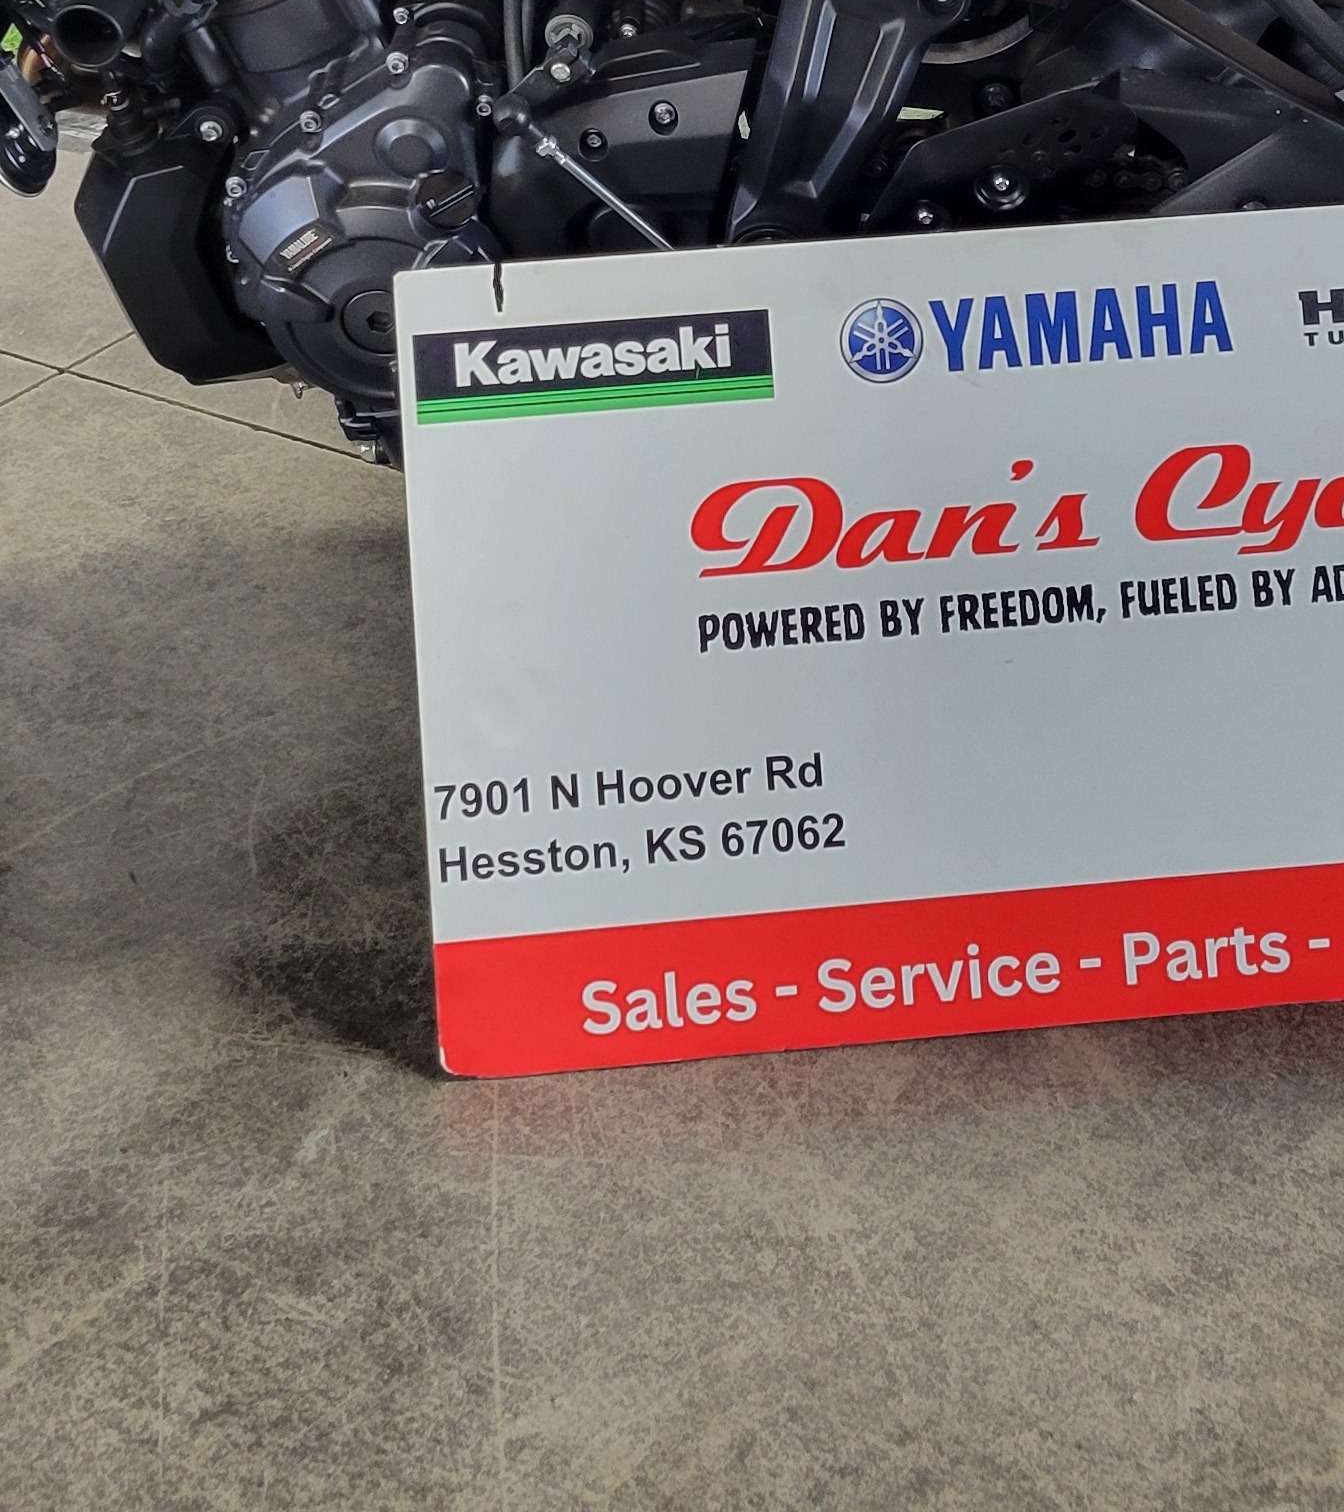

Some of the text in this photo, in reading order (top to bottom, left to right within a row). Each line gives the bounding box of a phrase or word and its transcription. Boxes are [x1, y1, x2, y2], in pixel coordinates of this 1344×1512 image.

[454, 324, 733, 390] Kawasaki
[928, 279, 1234, 373] YAMAHA
[689, 458, 1101, 580] Dan's
[697, 602, 866, 654] POWERED
[879, 597, 926, 638] BY
[939, 584, 1108, 634] FREEDOM,
[1119, 572, 1238, 620] FUELED
[1251, 568, 1296, 608] BY
[433, 752, 824, 821] 7901 N Hoover Rd
[438, 813, 847, 884] Hesston, KS 67062
[581, 971, 757, 1035] Sales
[817, 943, 1061, 1014] Service
[1121, 924, 1292, 986] Parts
